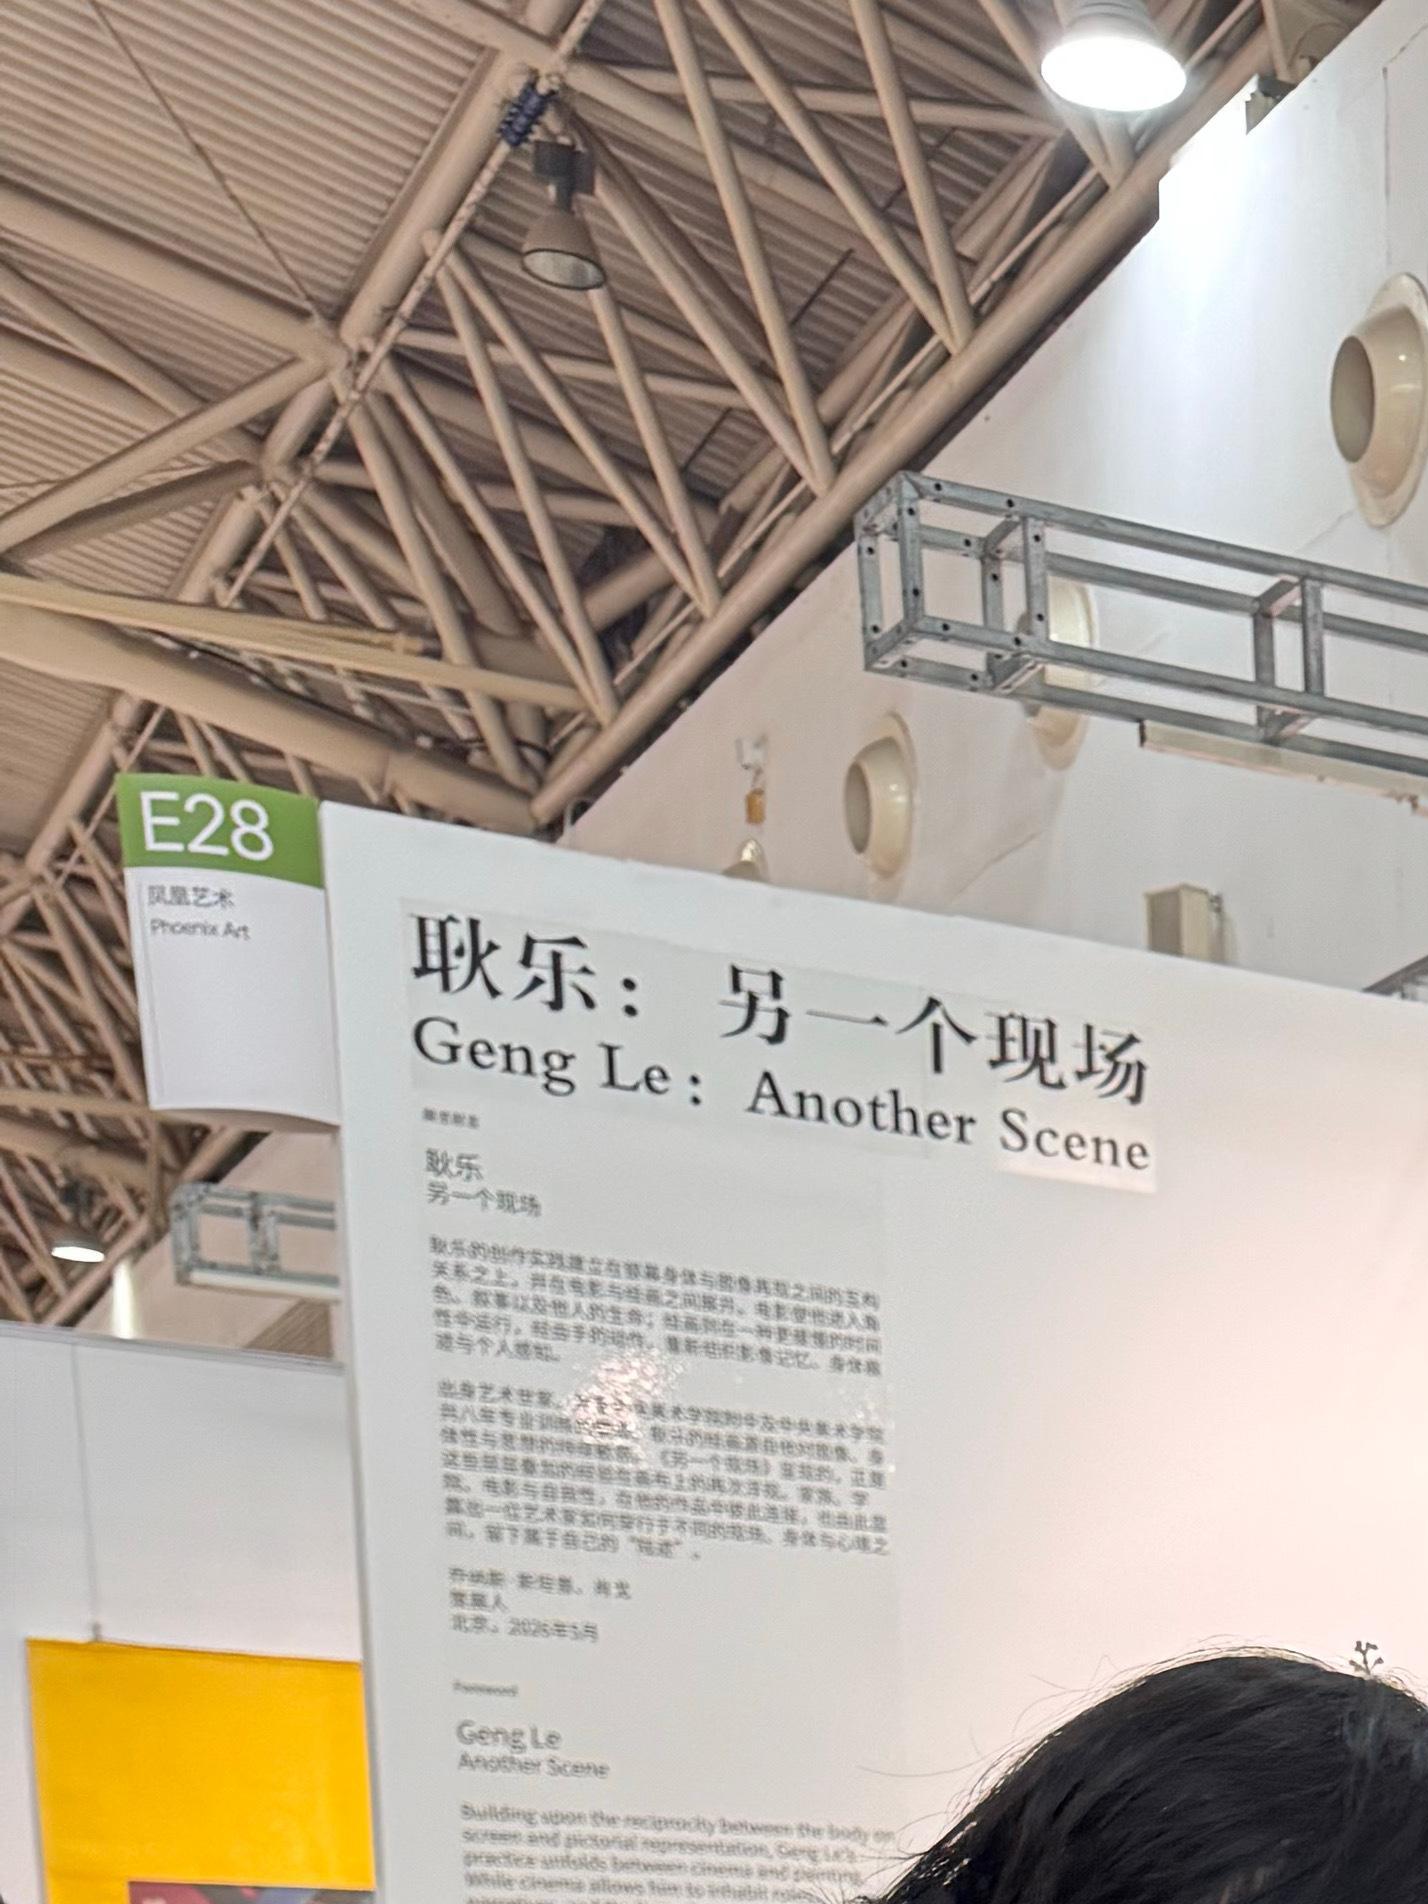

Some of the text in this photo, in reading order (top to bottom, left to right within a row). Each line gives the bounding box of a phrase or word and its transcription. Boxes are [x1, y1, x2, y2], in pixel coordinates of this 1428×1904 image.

[140, 791, 274, 861] E28
[148, 884, 234, 909] 凤凰艺术
[150, 919, 251, 940] Phoenix Art
[413, 1015, 577, 1098] Geng
[745, 1069, 977, 1146] Another
[1000, 1107, 1151, 1171] Scene
[425, 1147, 484, 1182] 耿乐
[427, 1180, 543, 1218] 另一个现场
[456, 1718, 561, 1753] Geng Le
[458, 1752, 610, 1780] Another Scene
